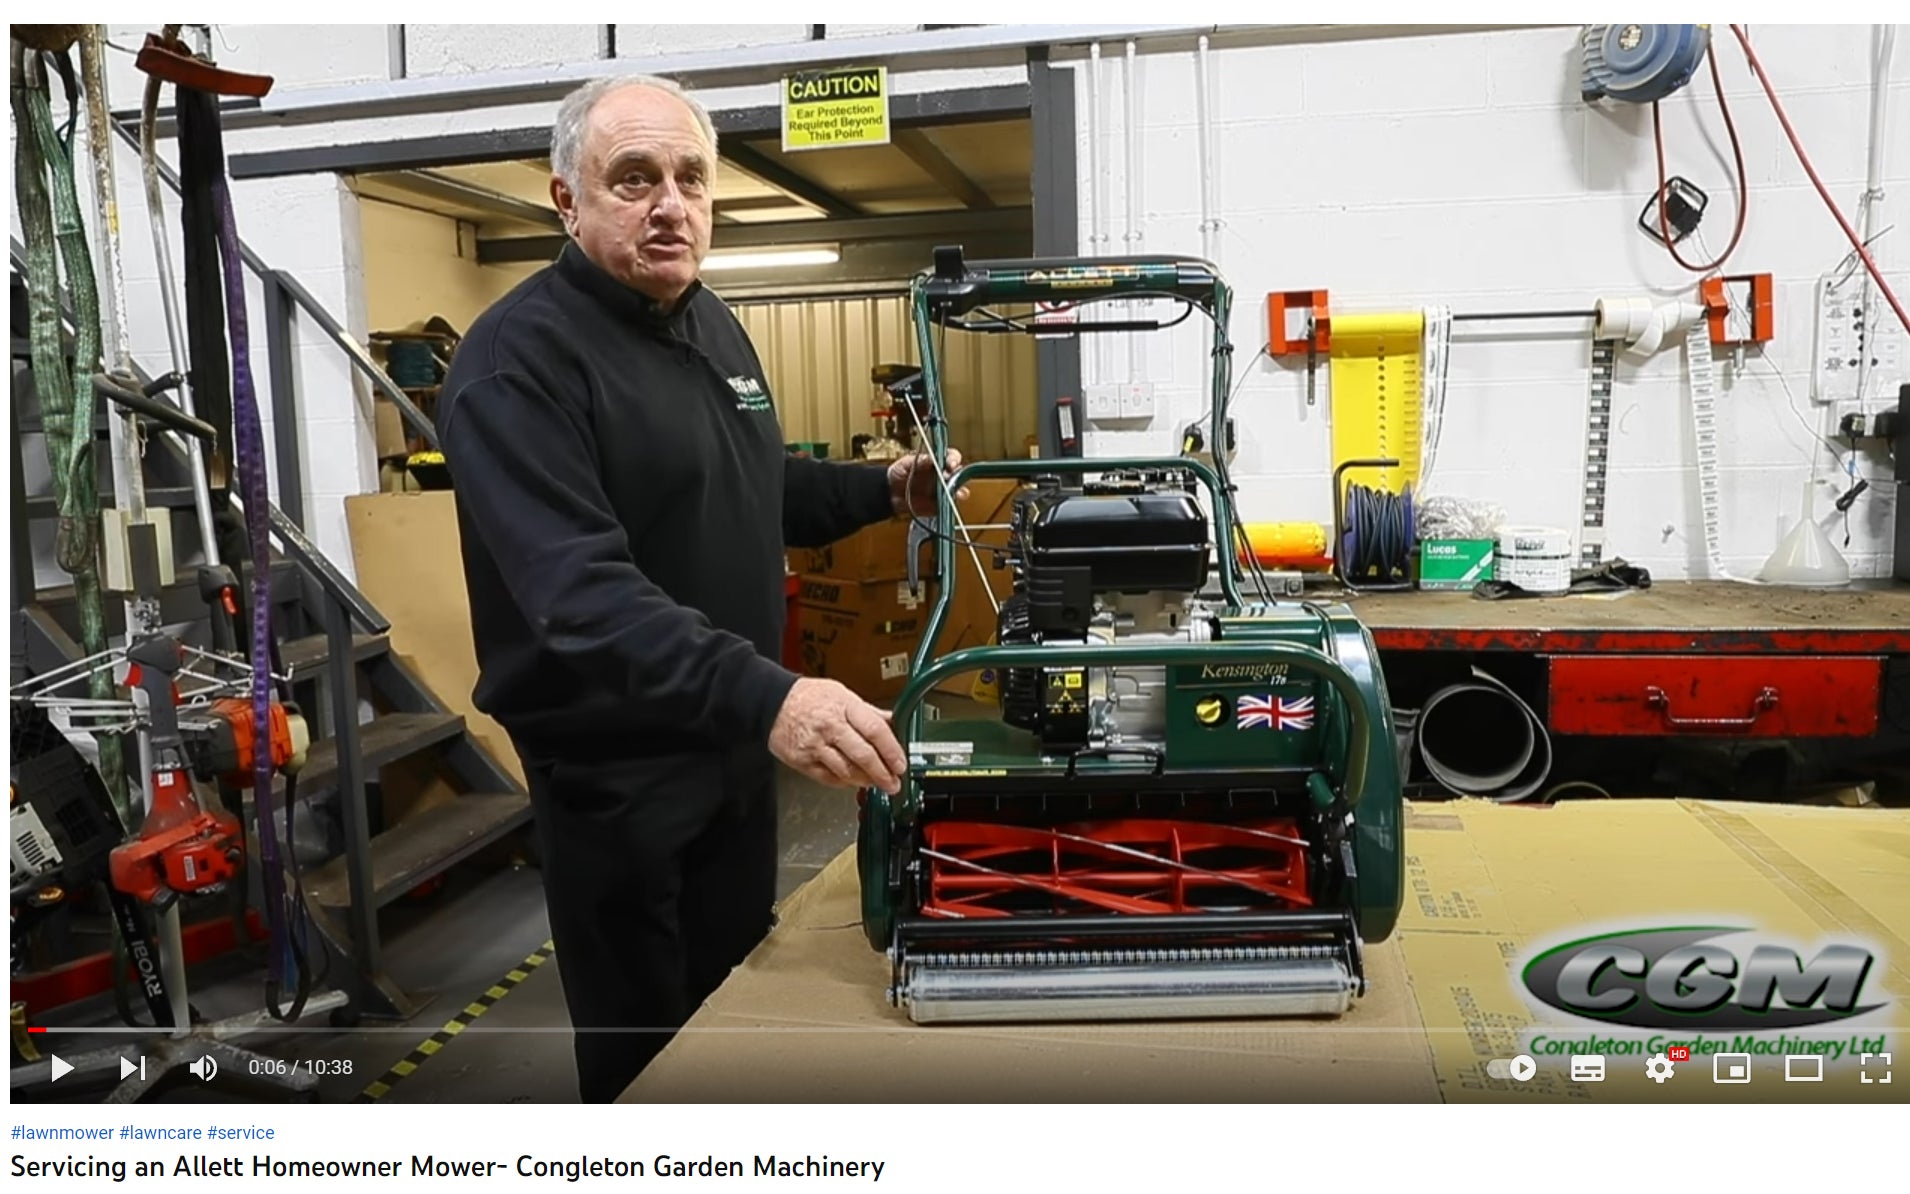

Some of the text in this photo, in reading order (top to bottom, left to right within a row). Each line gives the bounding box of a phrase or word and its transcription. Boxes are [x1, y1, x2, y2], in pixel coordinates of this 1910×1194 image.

[790, 74, 878, 99] CAUTION
[796, 104, 875, 120] Ear Protection
[789, 114, 883, 132] Required Beyond
[809, 128, 864, 141] This Point
[1427, 543, 1457, 554] Lucas
[1202, 663, 1289, 681] Kensington
[131, 940, 162, 998] RYOBI
